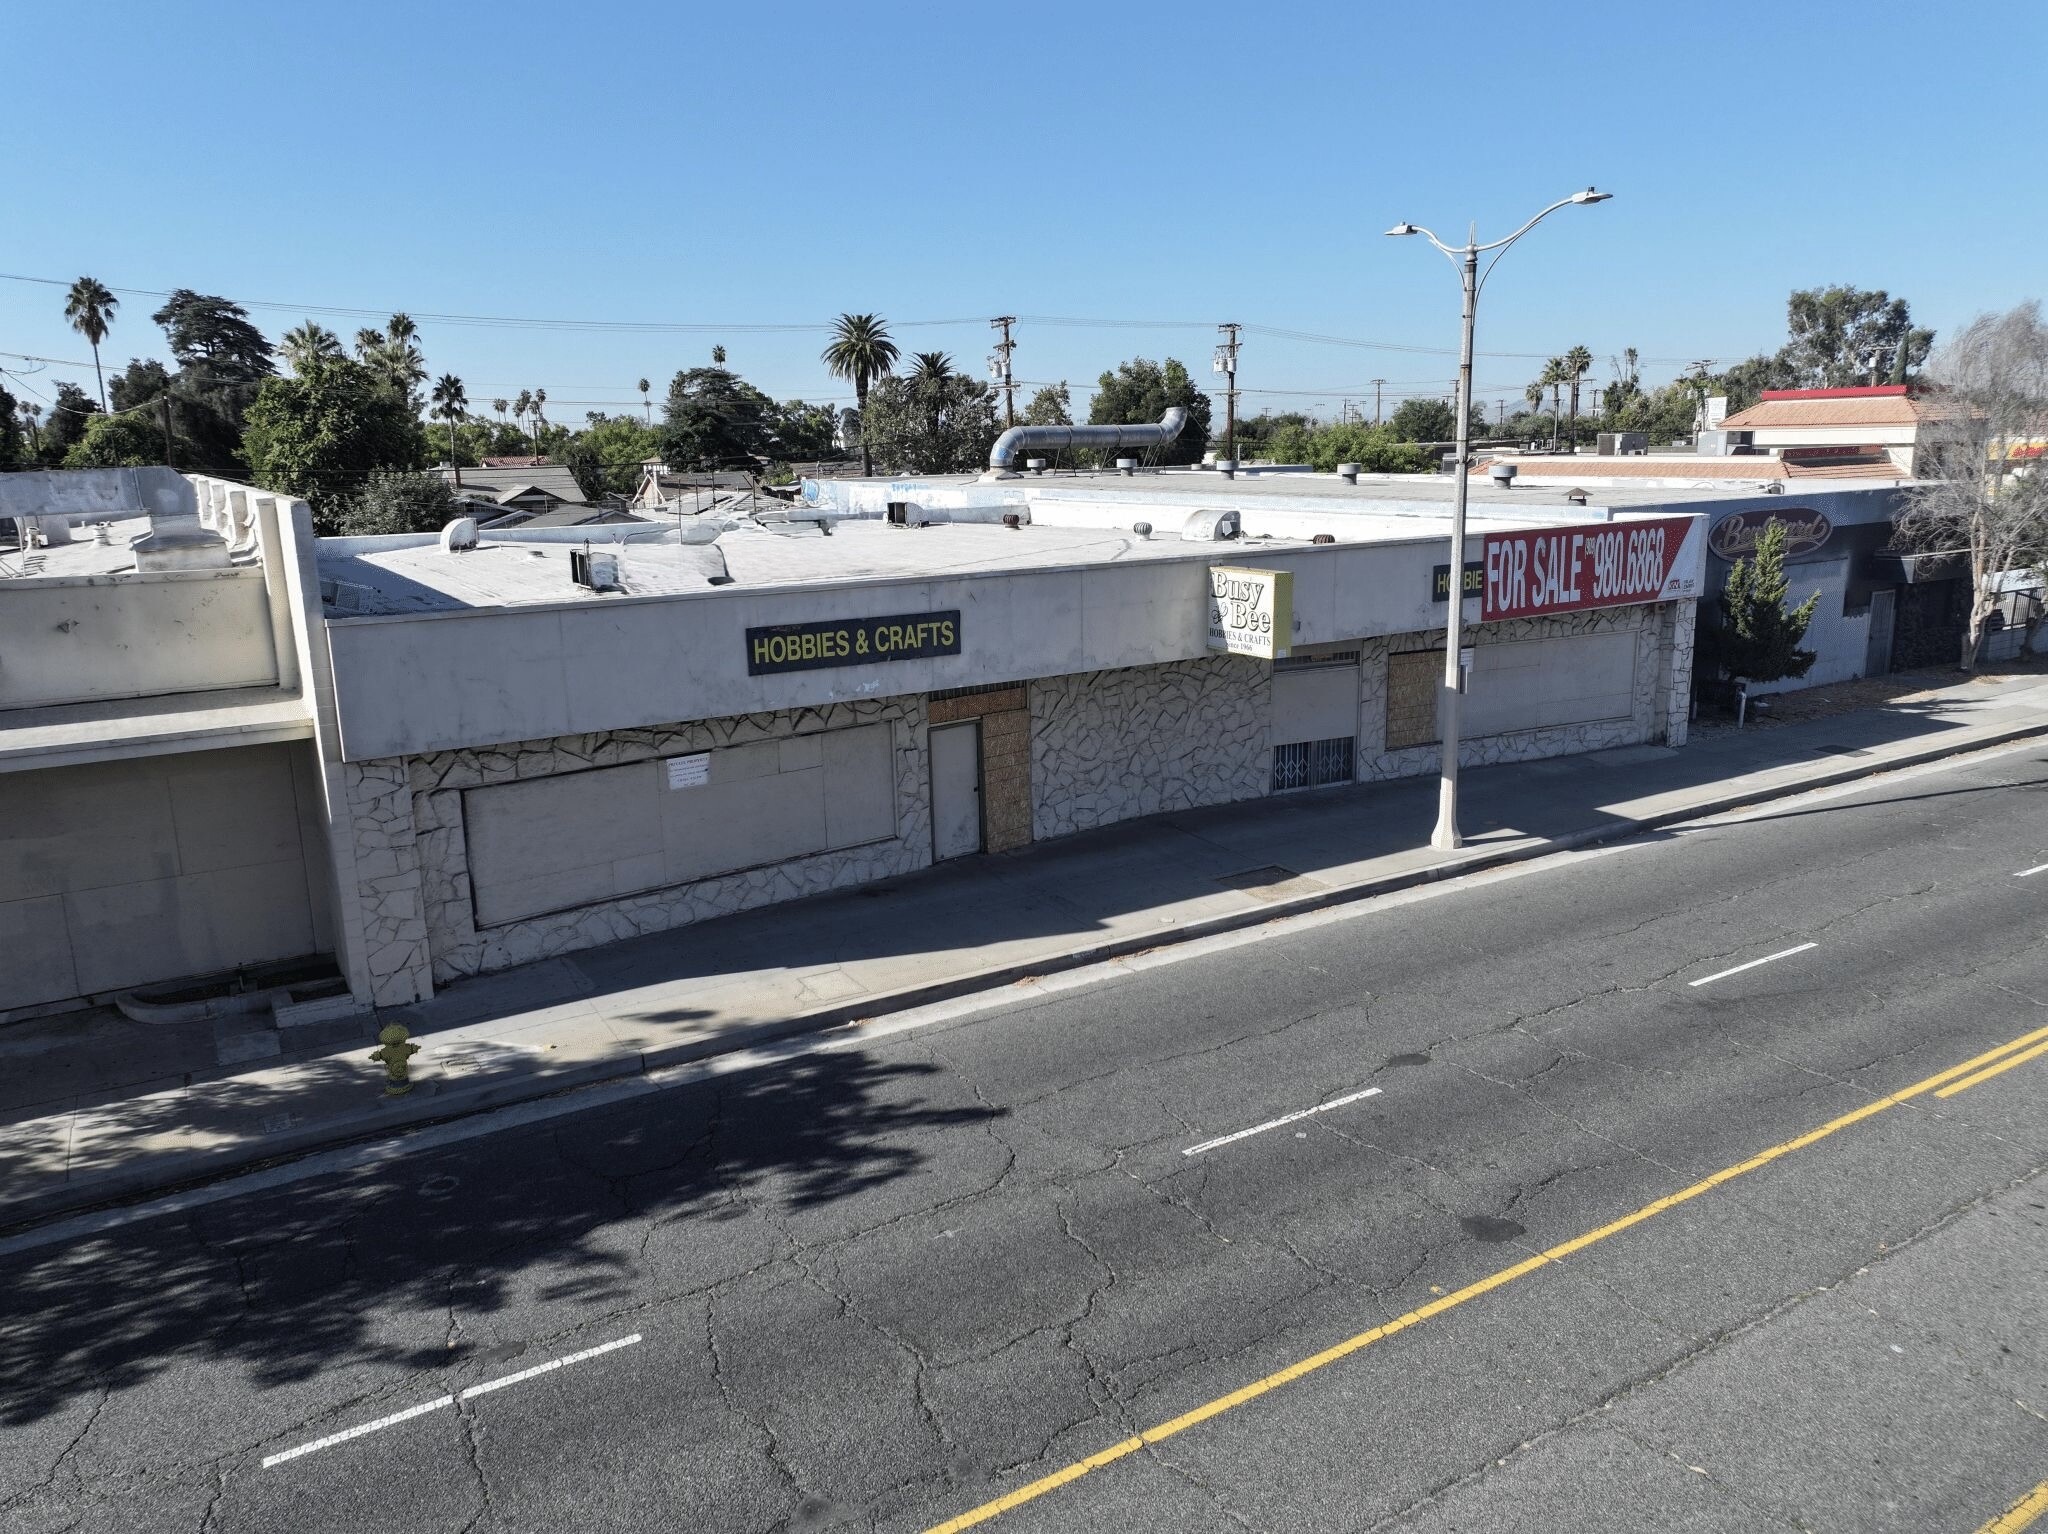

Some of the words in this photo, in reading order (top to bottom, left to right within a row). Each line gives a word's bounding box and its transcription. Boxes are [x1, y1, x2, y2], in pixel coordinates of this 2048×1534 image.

[1486, 539, 1527, 612] FOR
[1532, 534, 1583, 607] SALE
[1593, 527, 1665, 599] 980.6868
[1211, 571, 1264, 610] Busy
[1230, 600, 1271, 633] Bee
[754, 630, 849, 664] HOBBIES
[856, 629, 870, 654] &
[875, 620, 954, 652] CRAFTS
[1209, 627, 1236, 641] HOBBIES
[1237, 632, 1243, 642] &
[1244, 633, 1271, 646] CRAFTS
